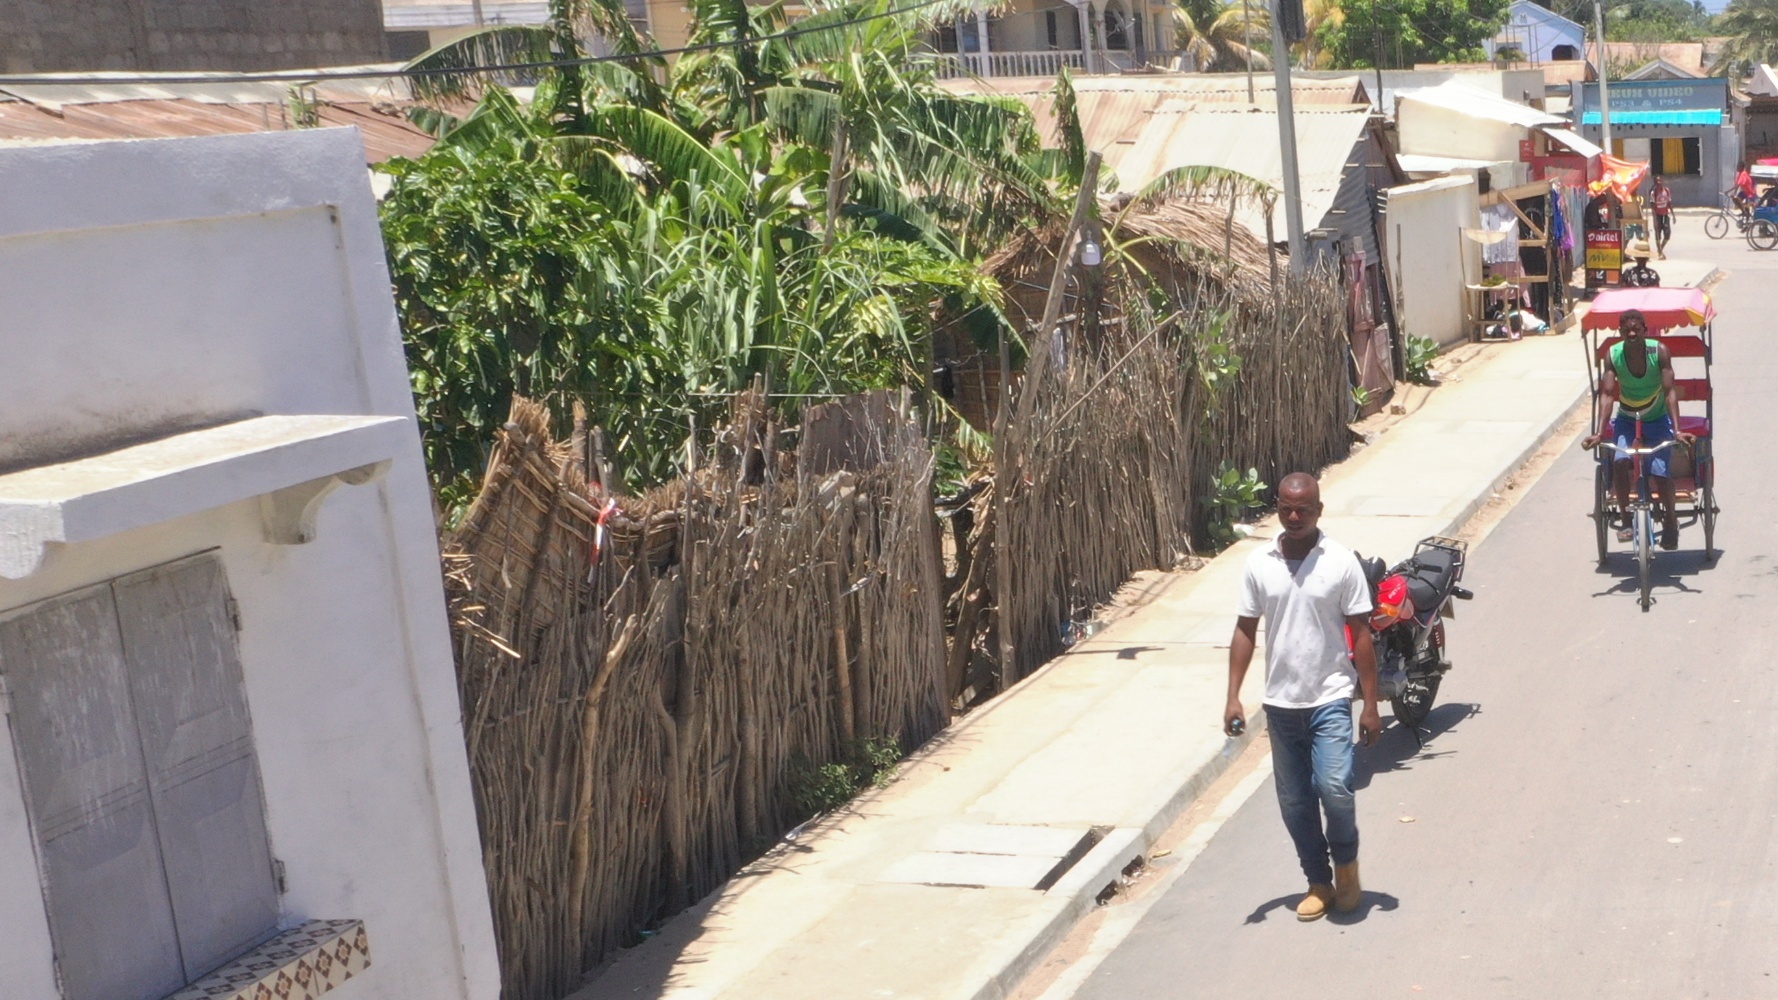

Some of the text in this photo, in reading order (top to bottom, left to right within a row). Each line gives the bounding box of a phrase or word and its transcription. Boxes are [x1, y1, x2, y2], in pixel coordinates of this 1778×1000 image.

[1647, 87, 1694, 97] VIDEO
[1641, 99, 1652, 107] &
[1659, 98, 1682, 106] PS4
[1595, 232, 1619, 242] airtel
